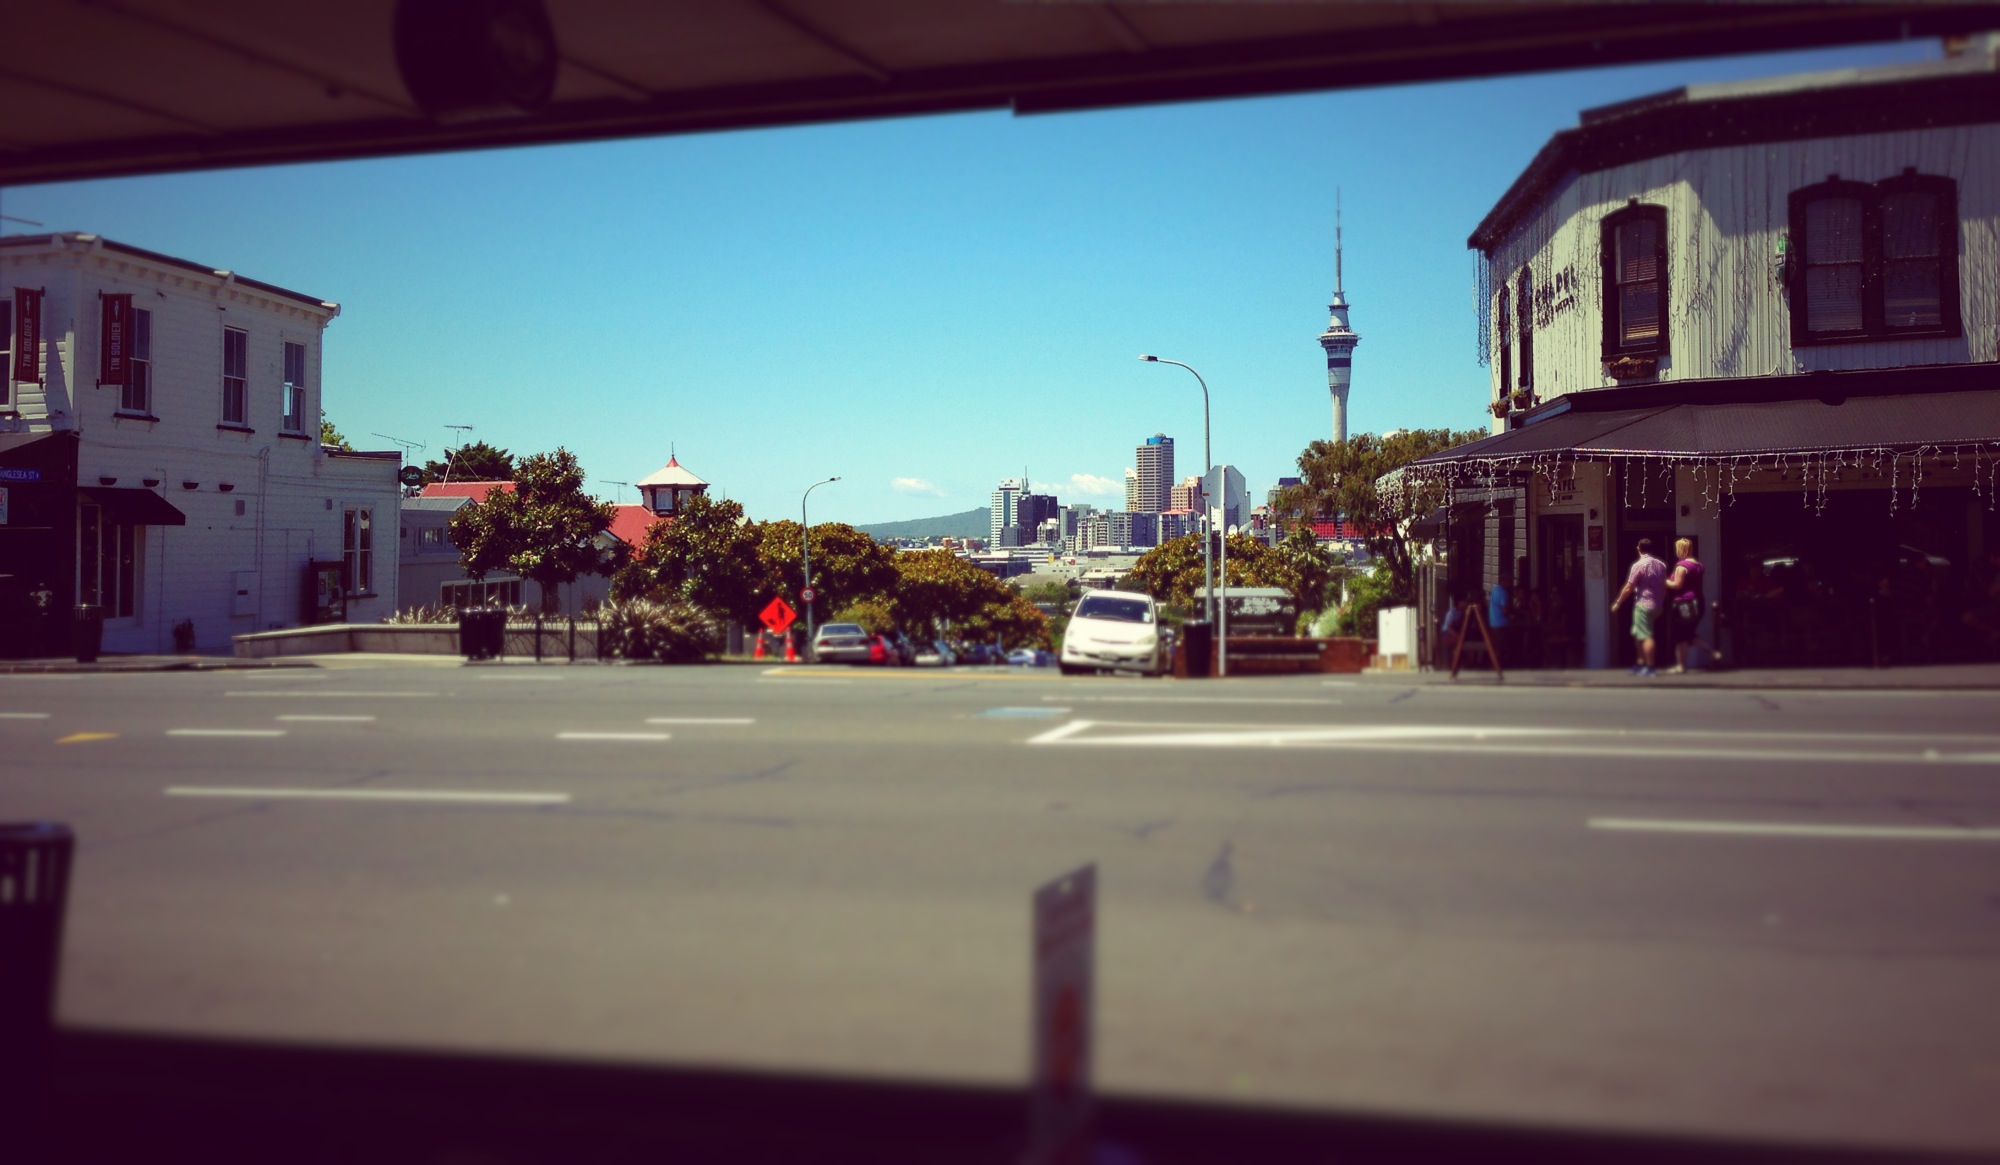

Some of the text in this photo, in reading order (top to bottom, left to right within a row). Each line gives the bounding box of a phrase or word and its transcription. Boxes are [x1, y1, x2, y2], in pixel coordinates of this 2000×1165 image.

[22, 317, 32, 367] TIN SOLDIER
[110, 322, 121, 371] TIN SOLDIER
[803, 591, 813, 599] 50
